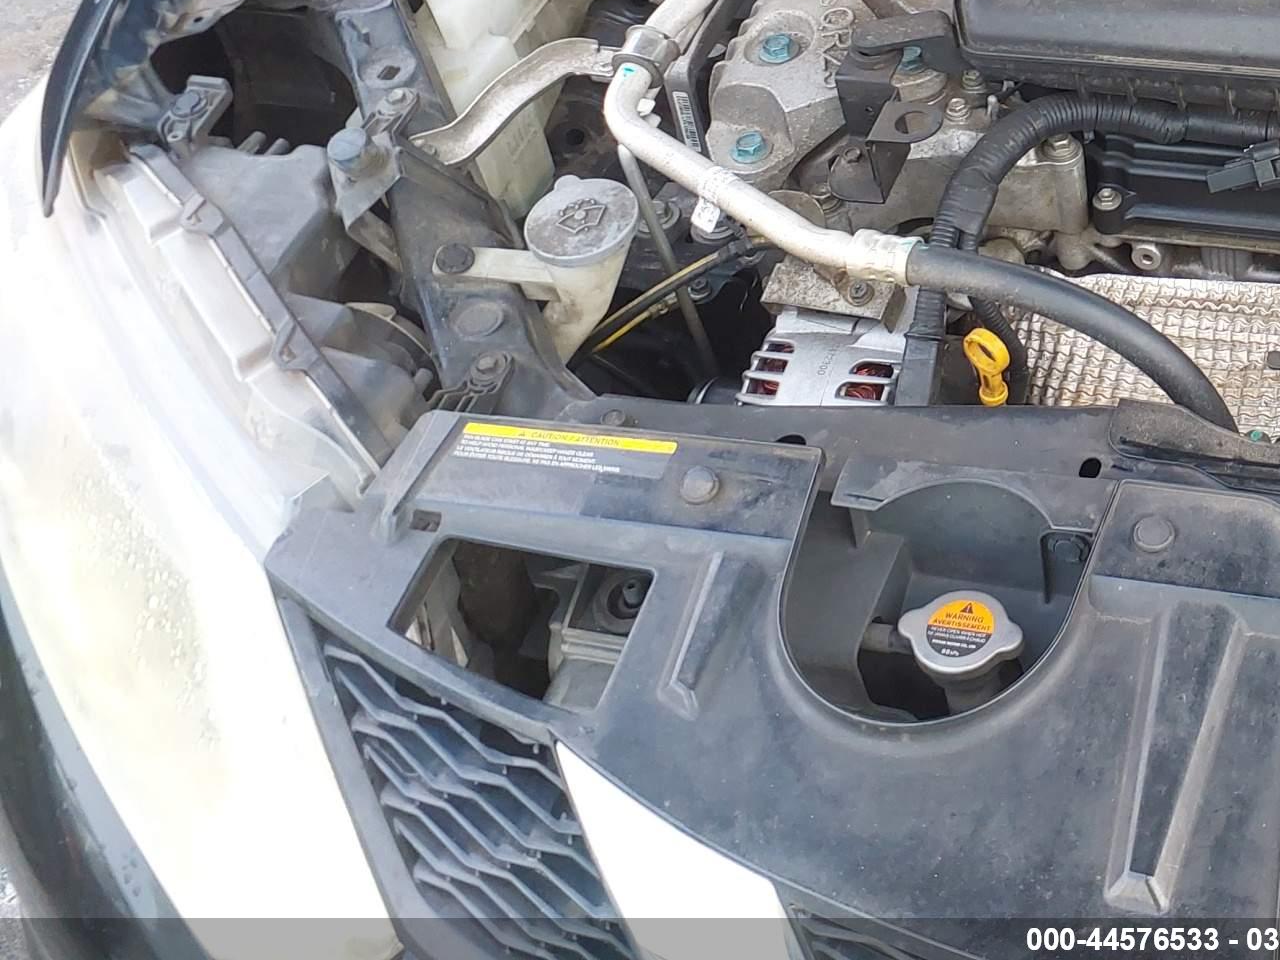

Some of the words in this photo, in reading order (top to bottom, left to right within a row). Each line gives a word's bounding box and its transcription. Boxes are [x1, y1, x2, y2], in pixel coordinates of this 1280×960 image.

[531, 430, 567, 441] CAUTION
[575, 435, 620, 447] ATTENTION
[932, 617, 991, 631] AVERTISSEMENT
[945, 612, 985, 623] WARNING
